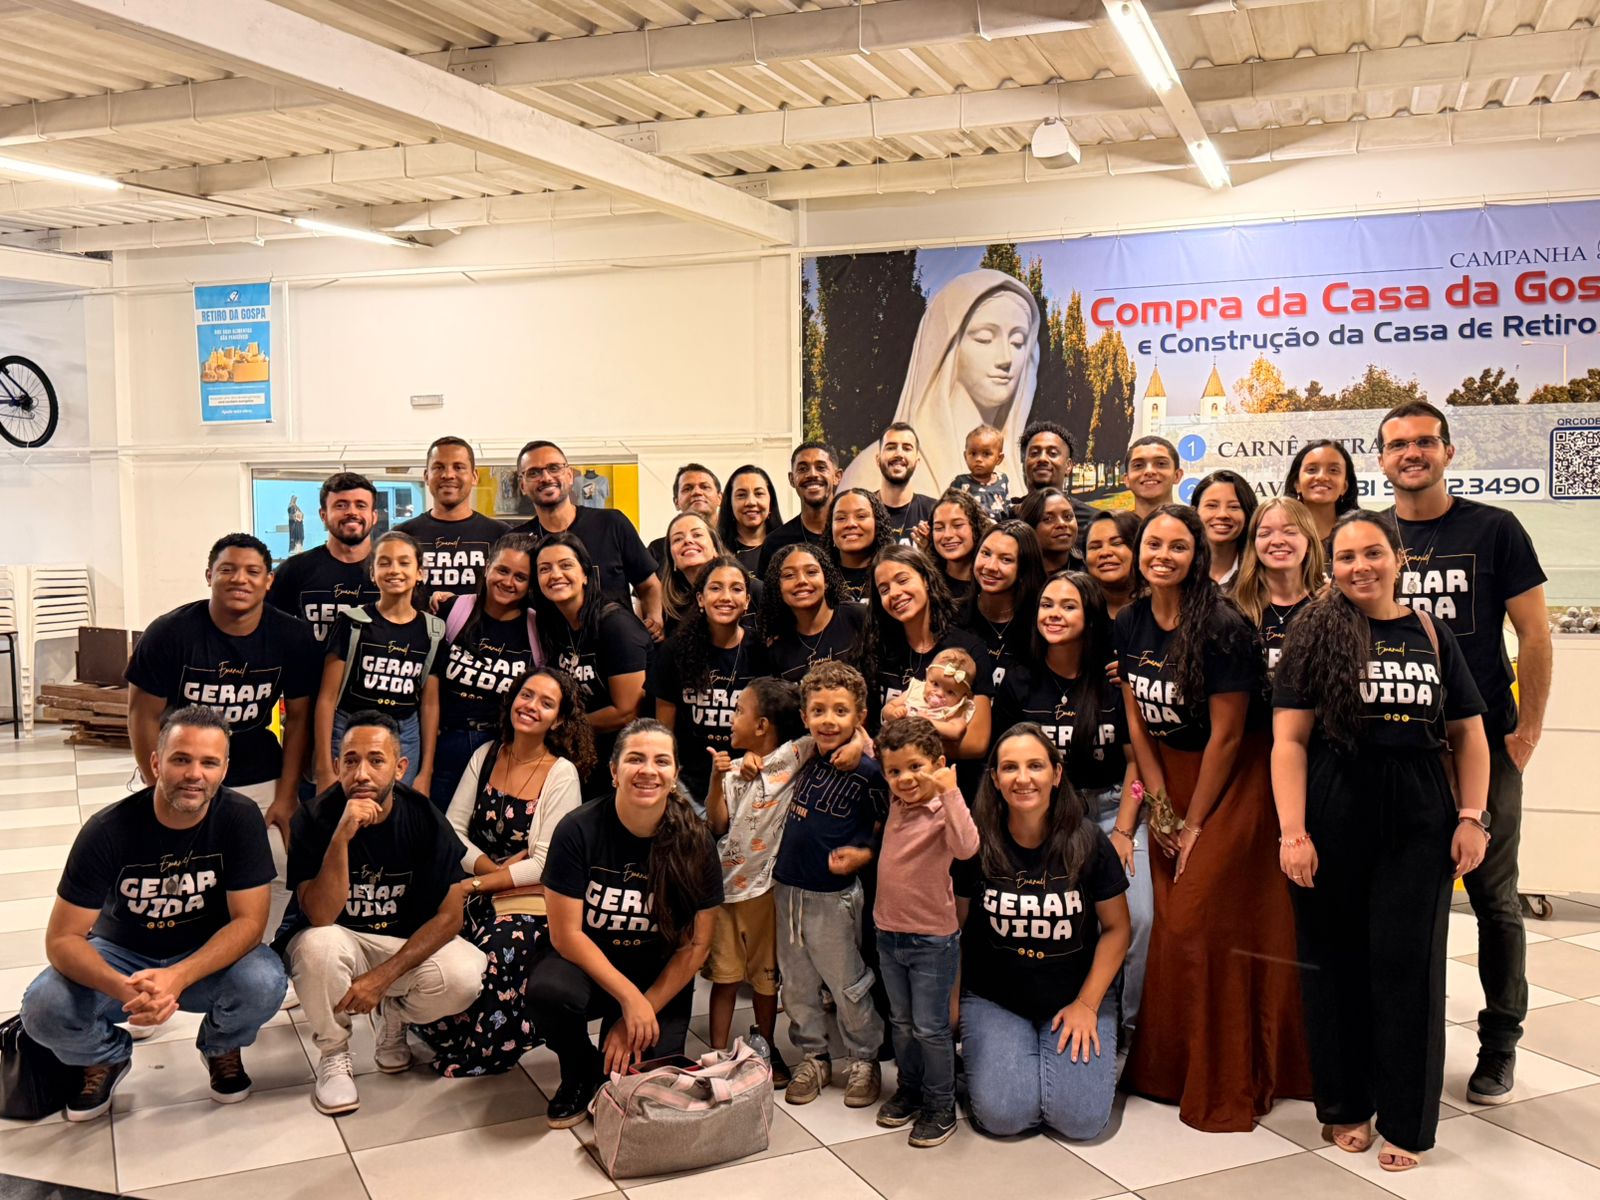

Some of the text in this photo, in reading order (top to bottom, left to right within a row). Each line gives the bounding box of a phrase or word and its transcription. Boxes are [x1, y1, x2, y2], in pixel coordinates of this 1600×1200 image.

[1450, 246, 1587, 268] CAMPANHA
[1091, 296, 1243, 329] Compra
[1257, 286, 1308, 317] da
[1322, 282, 1430, 314] Casa
[1445, 275, 1499, 307] da
[201, 307, 266, 322] RETIRO DA GOSPA
[1138, 313, 1597, 354] e Construção da Casa de Retiro
[1187, 441, 1196, 457] 1
[1218, 434, 1298, 458] CARNÊ
[423, 550, 485, 567] ERAR
[362, 655, 423, 678] GERAR
[446, 661, 514, 694] VIDA
[184, 682, 272, 703] GERAR
[364, 673, 415, 695] VIDA
[1128, 672, 1185, 705] ERAR
[1360, 682, 1433, 706] VIDA
[682, 688, 743, 707] GERA
[692, 705, 735, 727] VID
[128, 894, 204, 918] VIDA
[983, 888, 1083, 917] GERAR
[990, 916, 1073, 940] VIDA
